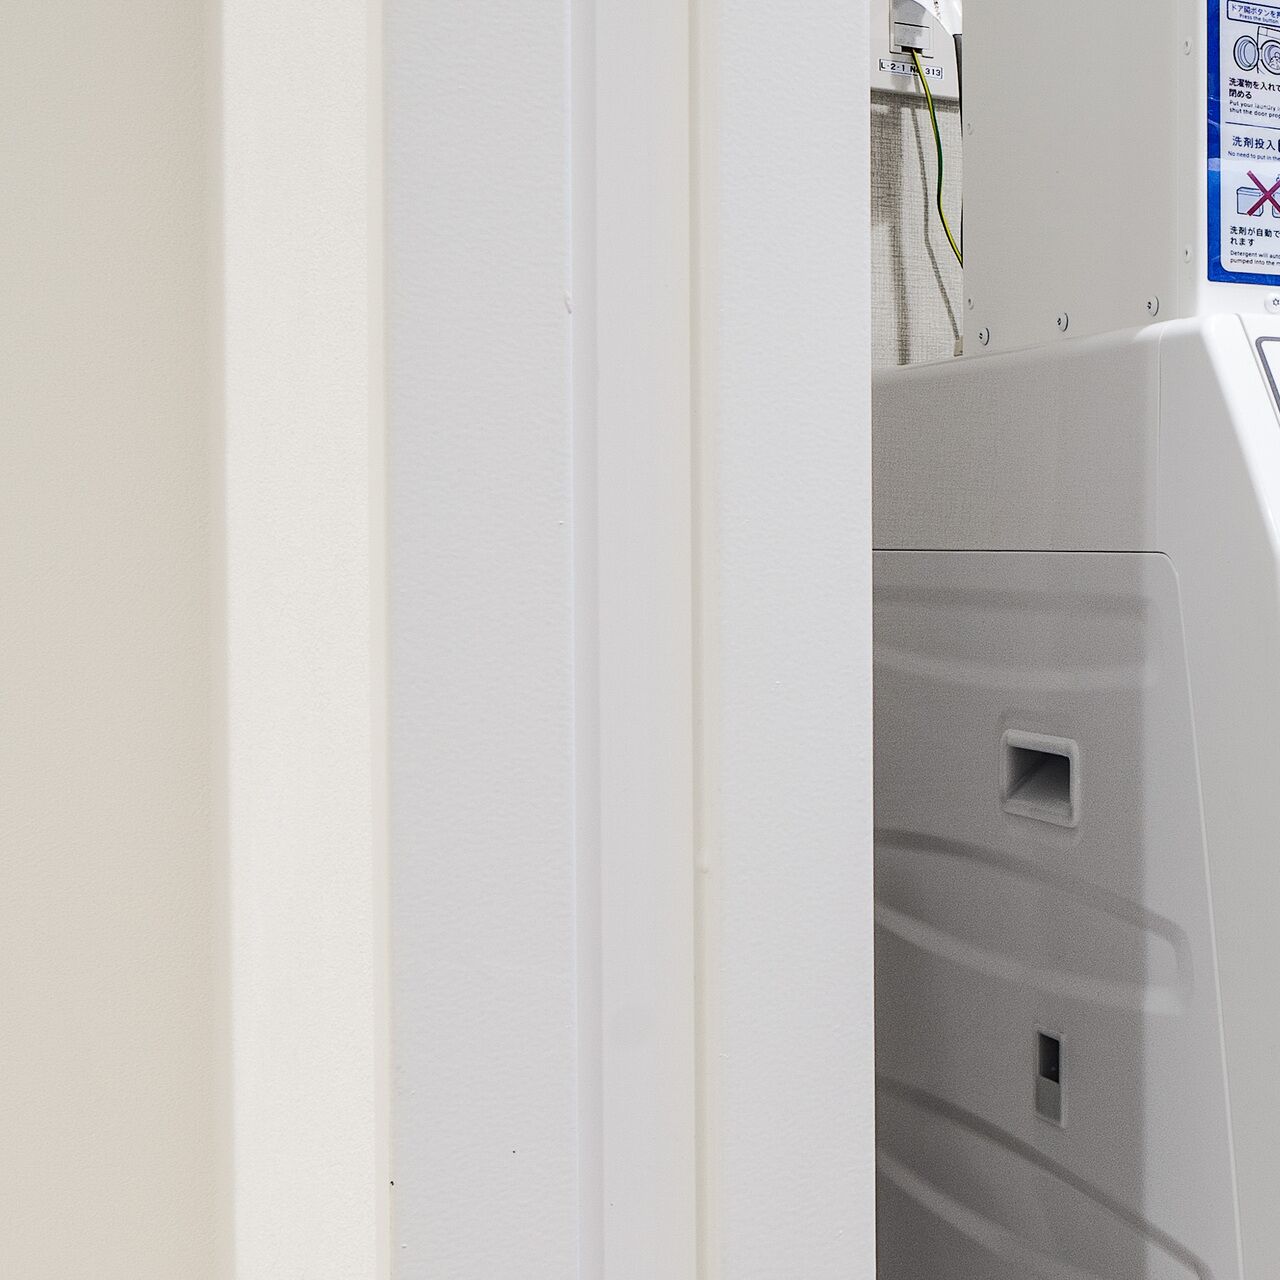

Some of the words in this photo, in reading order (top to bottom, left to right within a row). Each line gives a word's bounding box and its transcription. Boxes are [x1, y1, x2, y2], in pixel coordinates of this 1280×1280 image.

[925, 68, 941, 76] 313
[1229, 89, 1252, 99] 閉める
[1232, 136, 1276, 150] 洗剤投入
[1230, 238, 1254, 246] れます
[1230, 250, 1257, 258] Detergent
